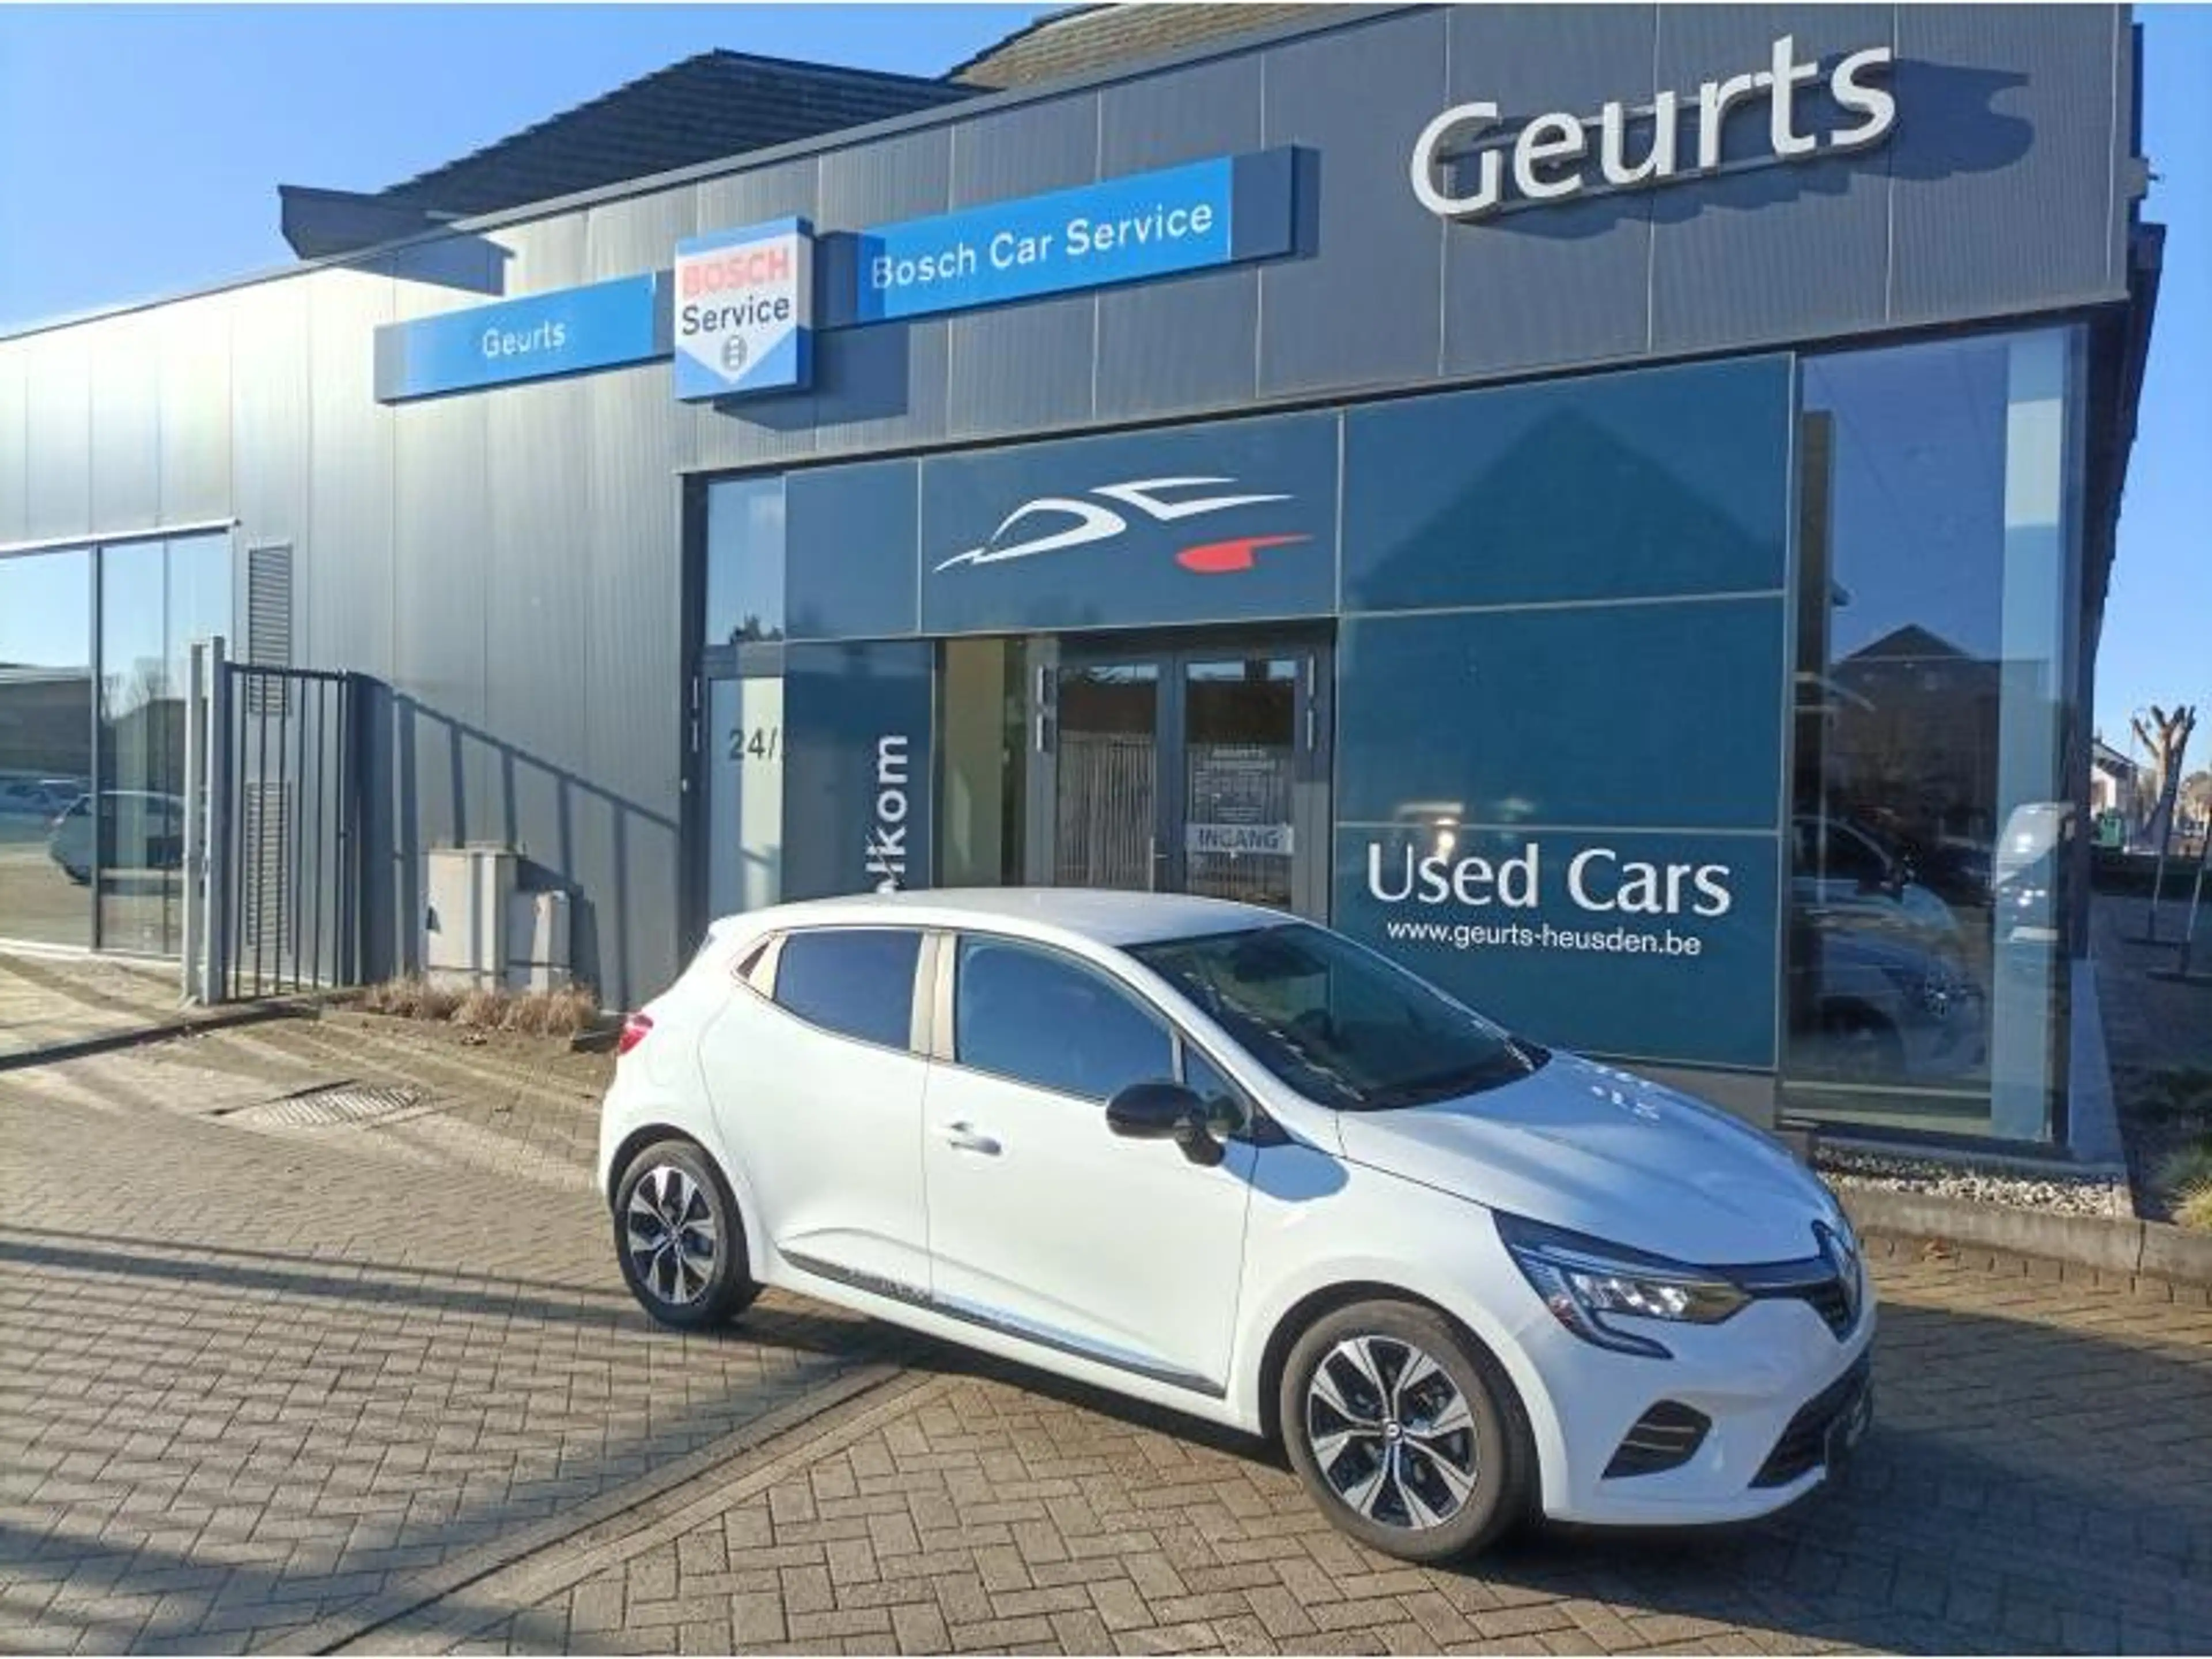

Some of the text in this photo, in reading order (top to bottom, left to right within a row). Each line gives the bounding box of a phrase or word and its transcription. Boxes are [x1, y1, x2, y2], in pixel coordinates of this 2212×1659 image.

[1410, 35, 1896, 219] Geurts
[682, 245, 790, 296] BOSCH
[872, 203, 1213, 288] Bosch Car Service
[482, 320, 566, 358] Geurts
[682, 295, 790, 335] Service
[1367, 842, 1731, 916] Used Cars
[1387, 921, 1702, 956] www.geurts-heusden.be
